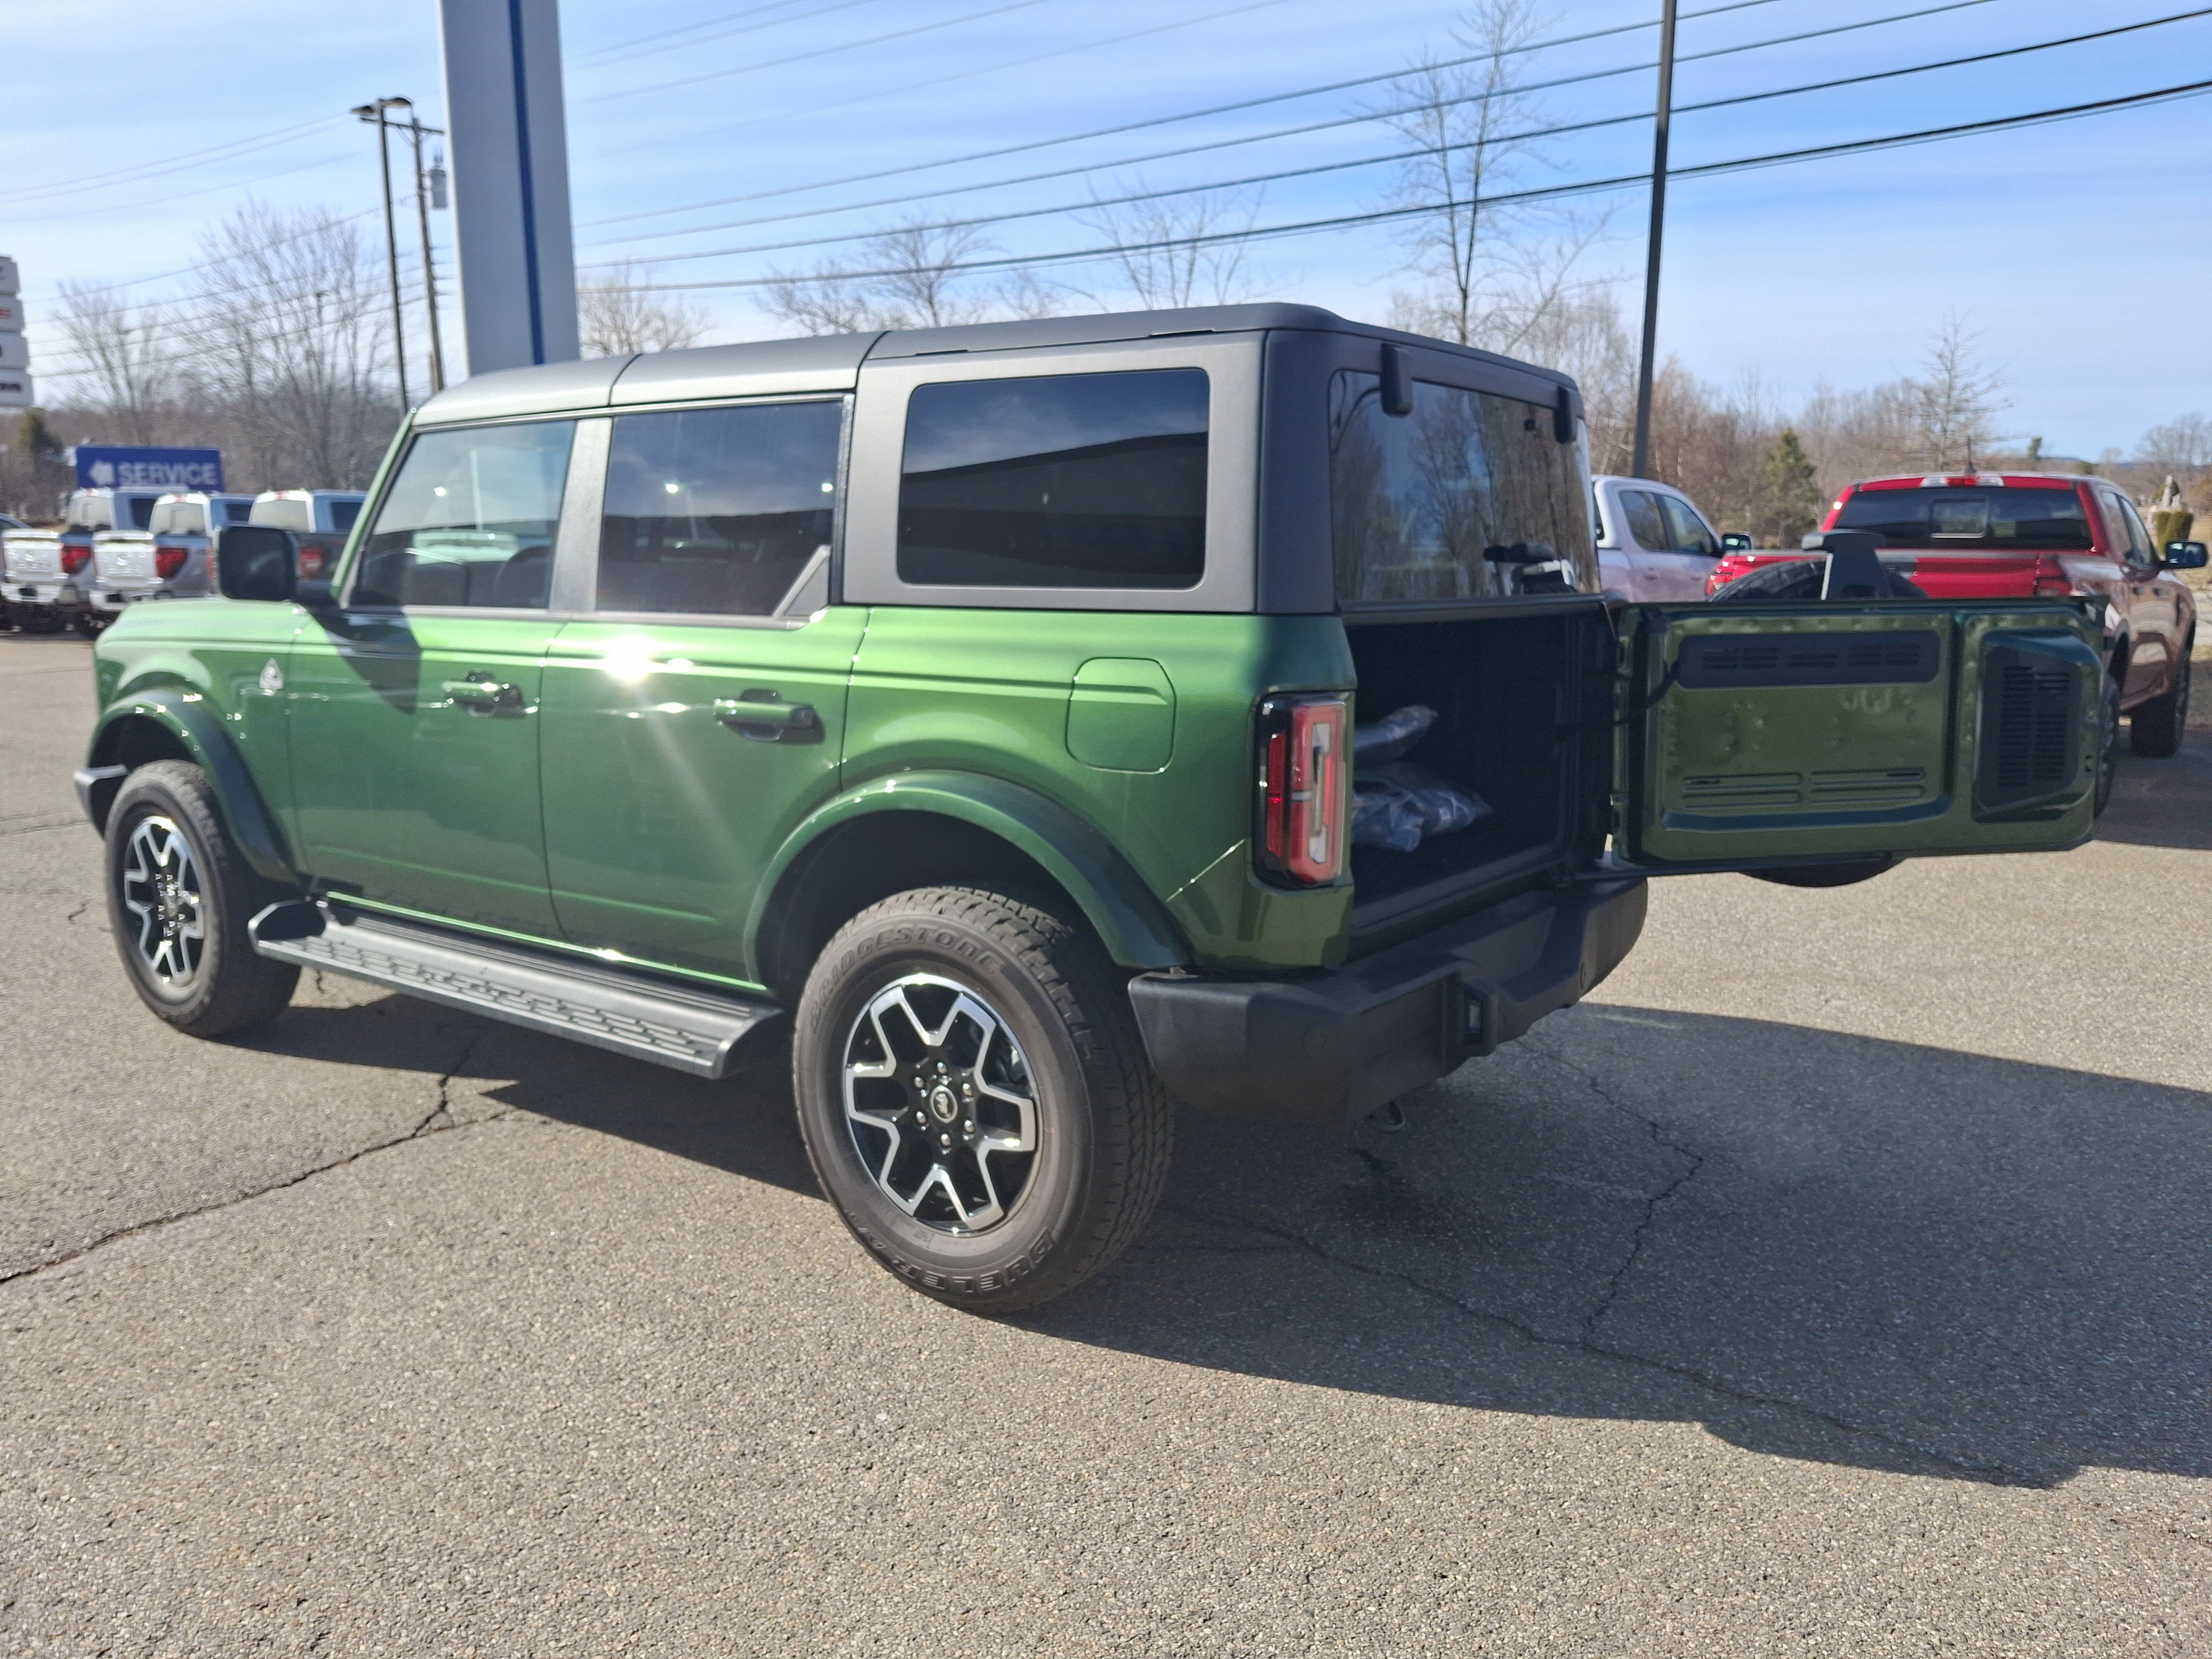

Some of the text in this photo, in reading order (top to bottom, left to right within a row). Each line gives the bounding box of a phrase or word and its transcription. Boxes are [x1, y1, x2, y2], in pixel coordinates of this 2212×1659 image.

[118, 462, 217, 485] SERVICE
[812, 923, 1005, 1028] BRIDGESTONE
[891, 1227, 1056, 1293] DUELER
